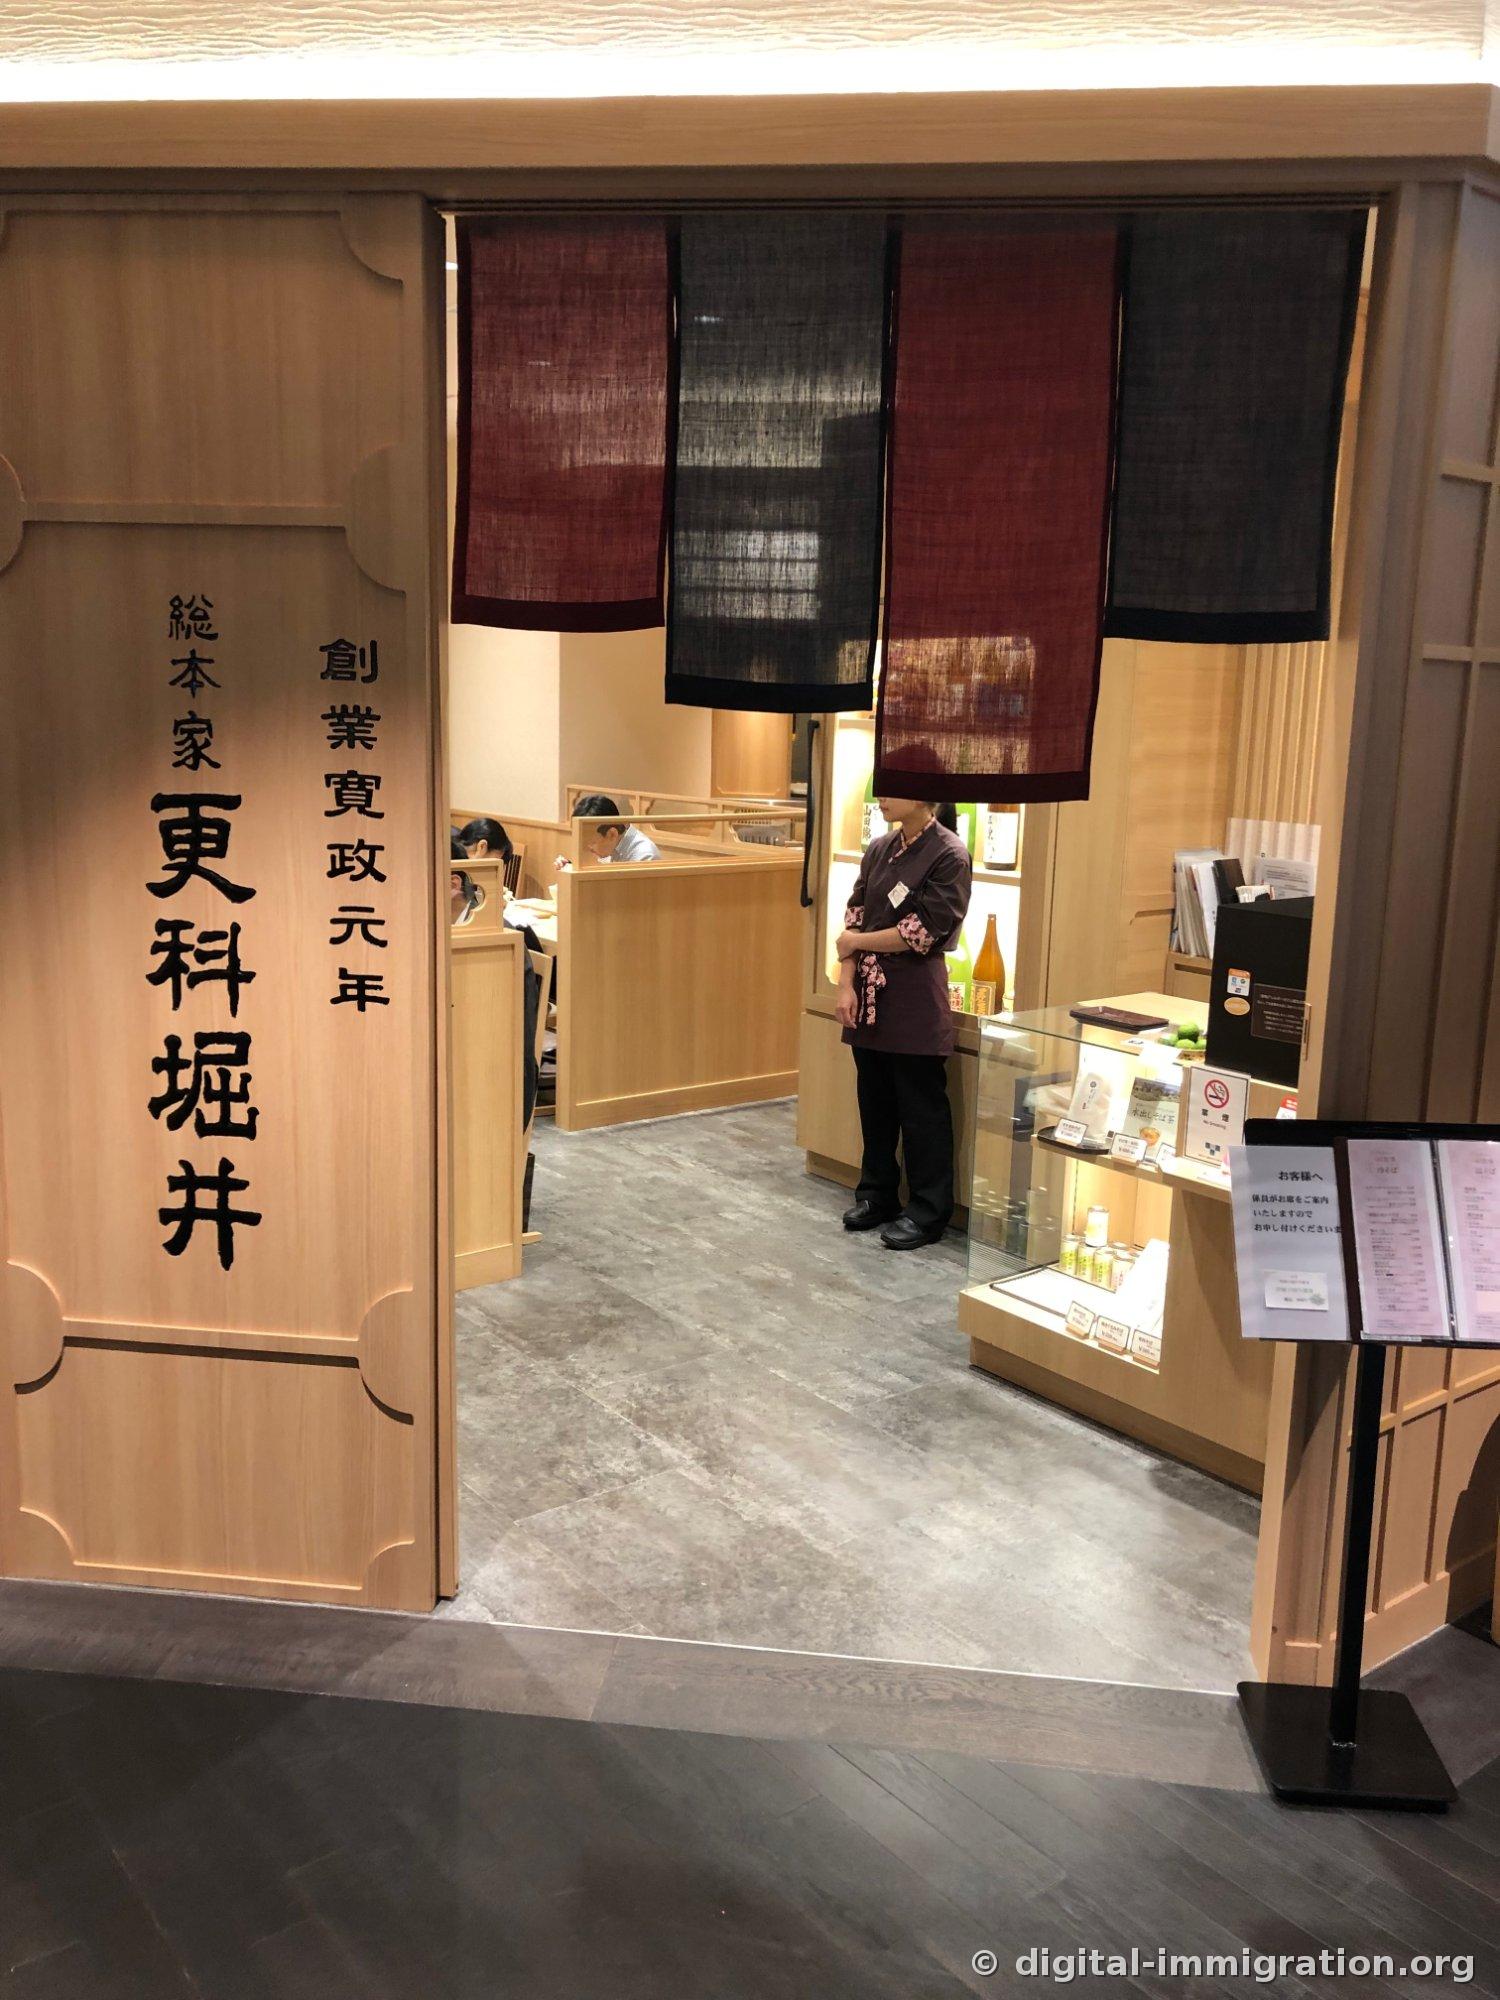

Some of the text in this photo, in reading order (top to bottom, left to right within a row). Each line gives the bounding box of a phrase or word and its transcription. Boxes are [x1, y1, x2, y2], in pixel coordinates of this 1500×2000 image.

[1278, 1171, 1324, 1181] お客様へ
[1252, 1194, 1329, 1204] 係員がお席をご案内
[1253, 1209, 1313, 1218] いたしますので
